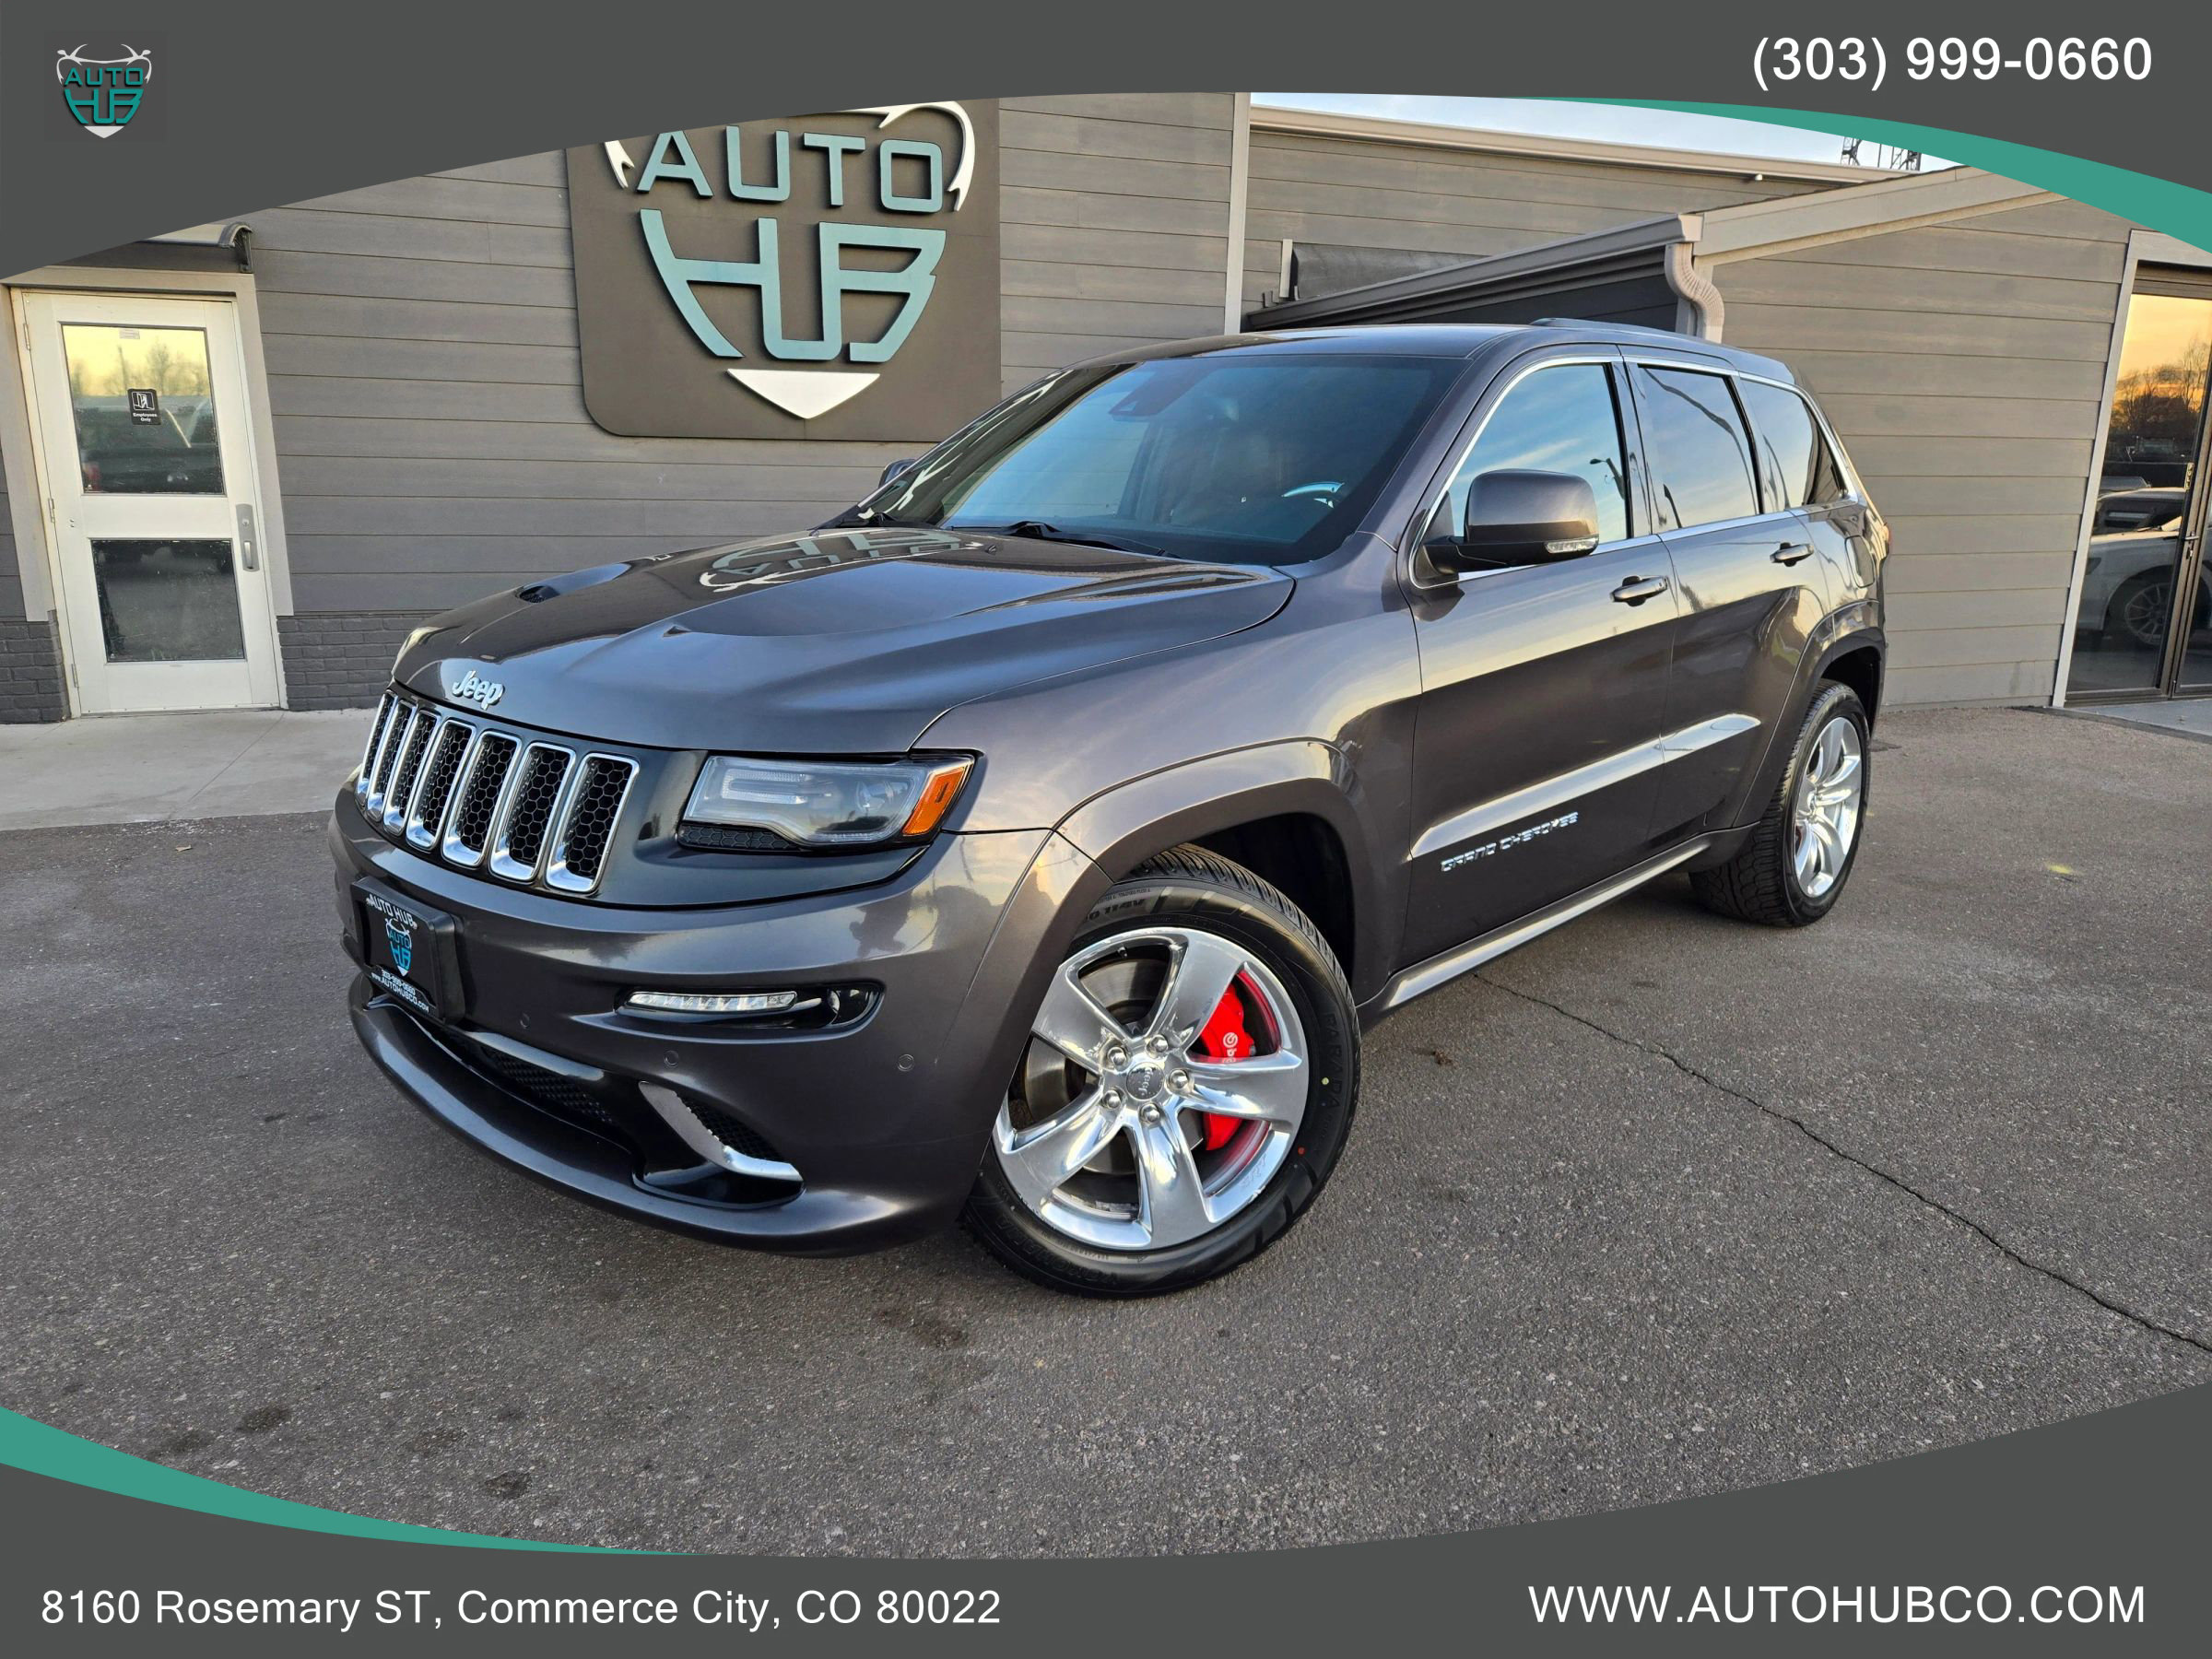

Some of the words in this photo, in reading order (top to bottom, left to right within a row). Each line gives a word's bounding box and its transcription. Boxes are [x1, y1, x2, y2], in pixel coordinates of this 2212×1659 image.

[637, 125, 945, 214] AUTO
[640, 208, 947, 363] HUB
[452, 670, 505, 711] Jeep
[1441, 842, 1497, 872] GRAND
[1500, 811, 1579, 850] CHEROKEE
[370, 893, 394, 917] AUTO
[393, 905, 415, 927] HUB
[389, 932, 411, 949] AUTO
[390, 940, 411, 971] HUB
